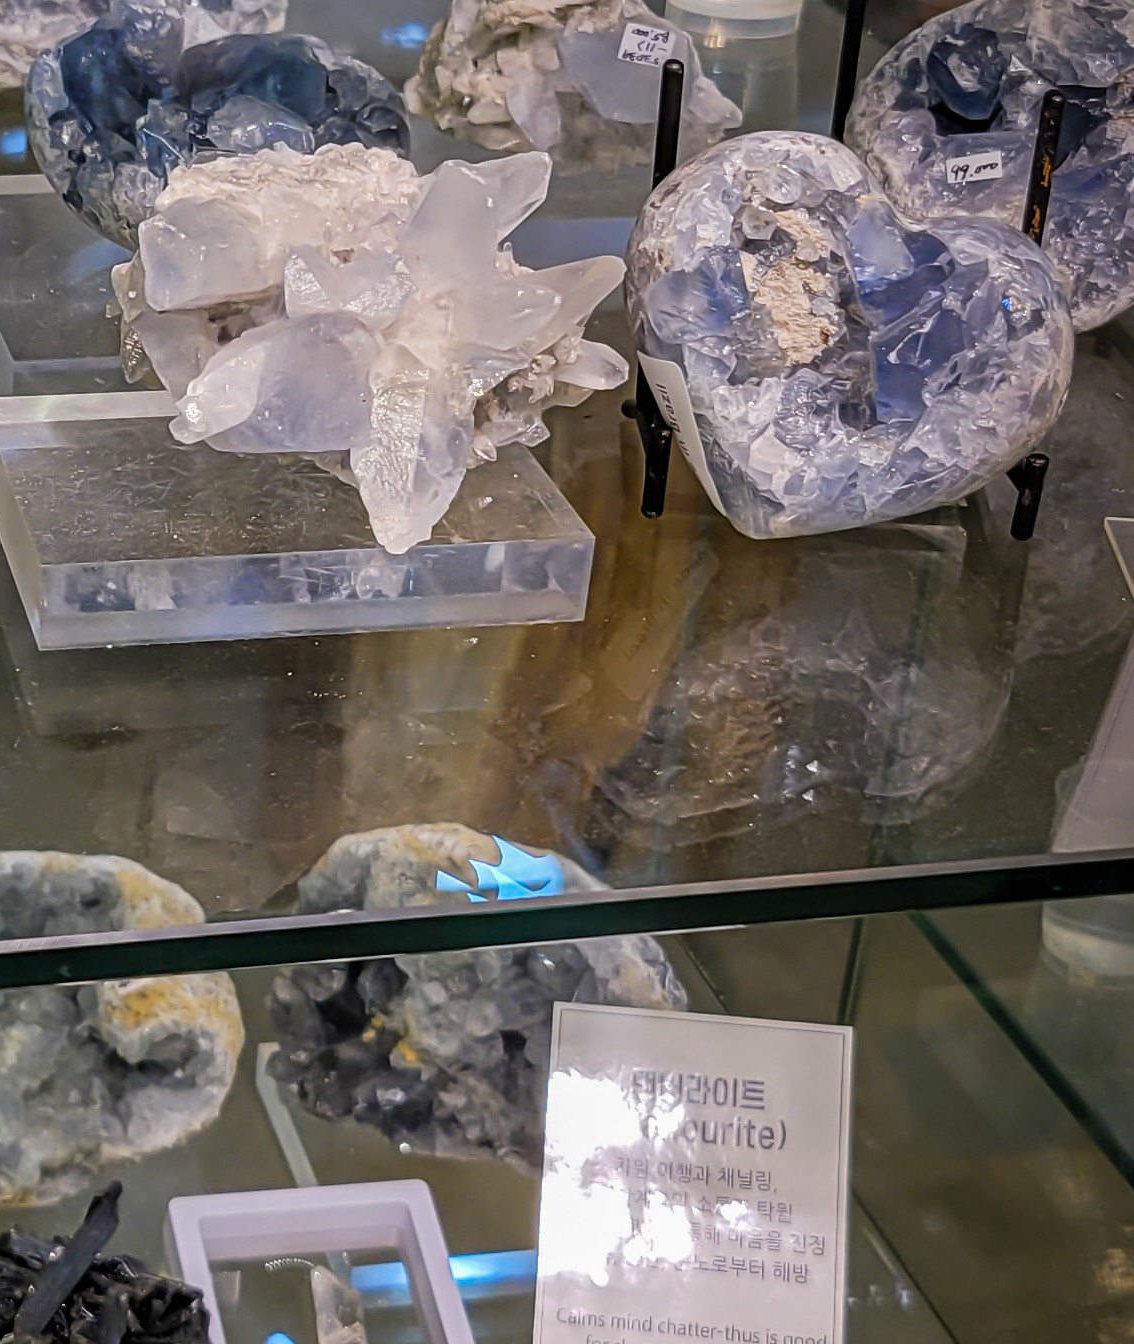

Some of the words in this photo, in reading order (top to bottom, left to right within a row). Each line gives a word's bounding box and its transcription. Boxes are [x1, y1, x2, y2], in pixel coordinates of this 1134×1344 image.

[716, 1166, 780, 1194] 채널링,
[790, 1233, 827, 1258] 진정
[772, 1259, 811, 1286] 해방
[555, 1306, 606, 1329] Calms
[610, 1313, 653, 1333] mind
[657, 1317, 761, 1344] chatter-thus
